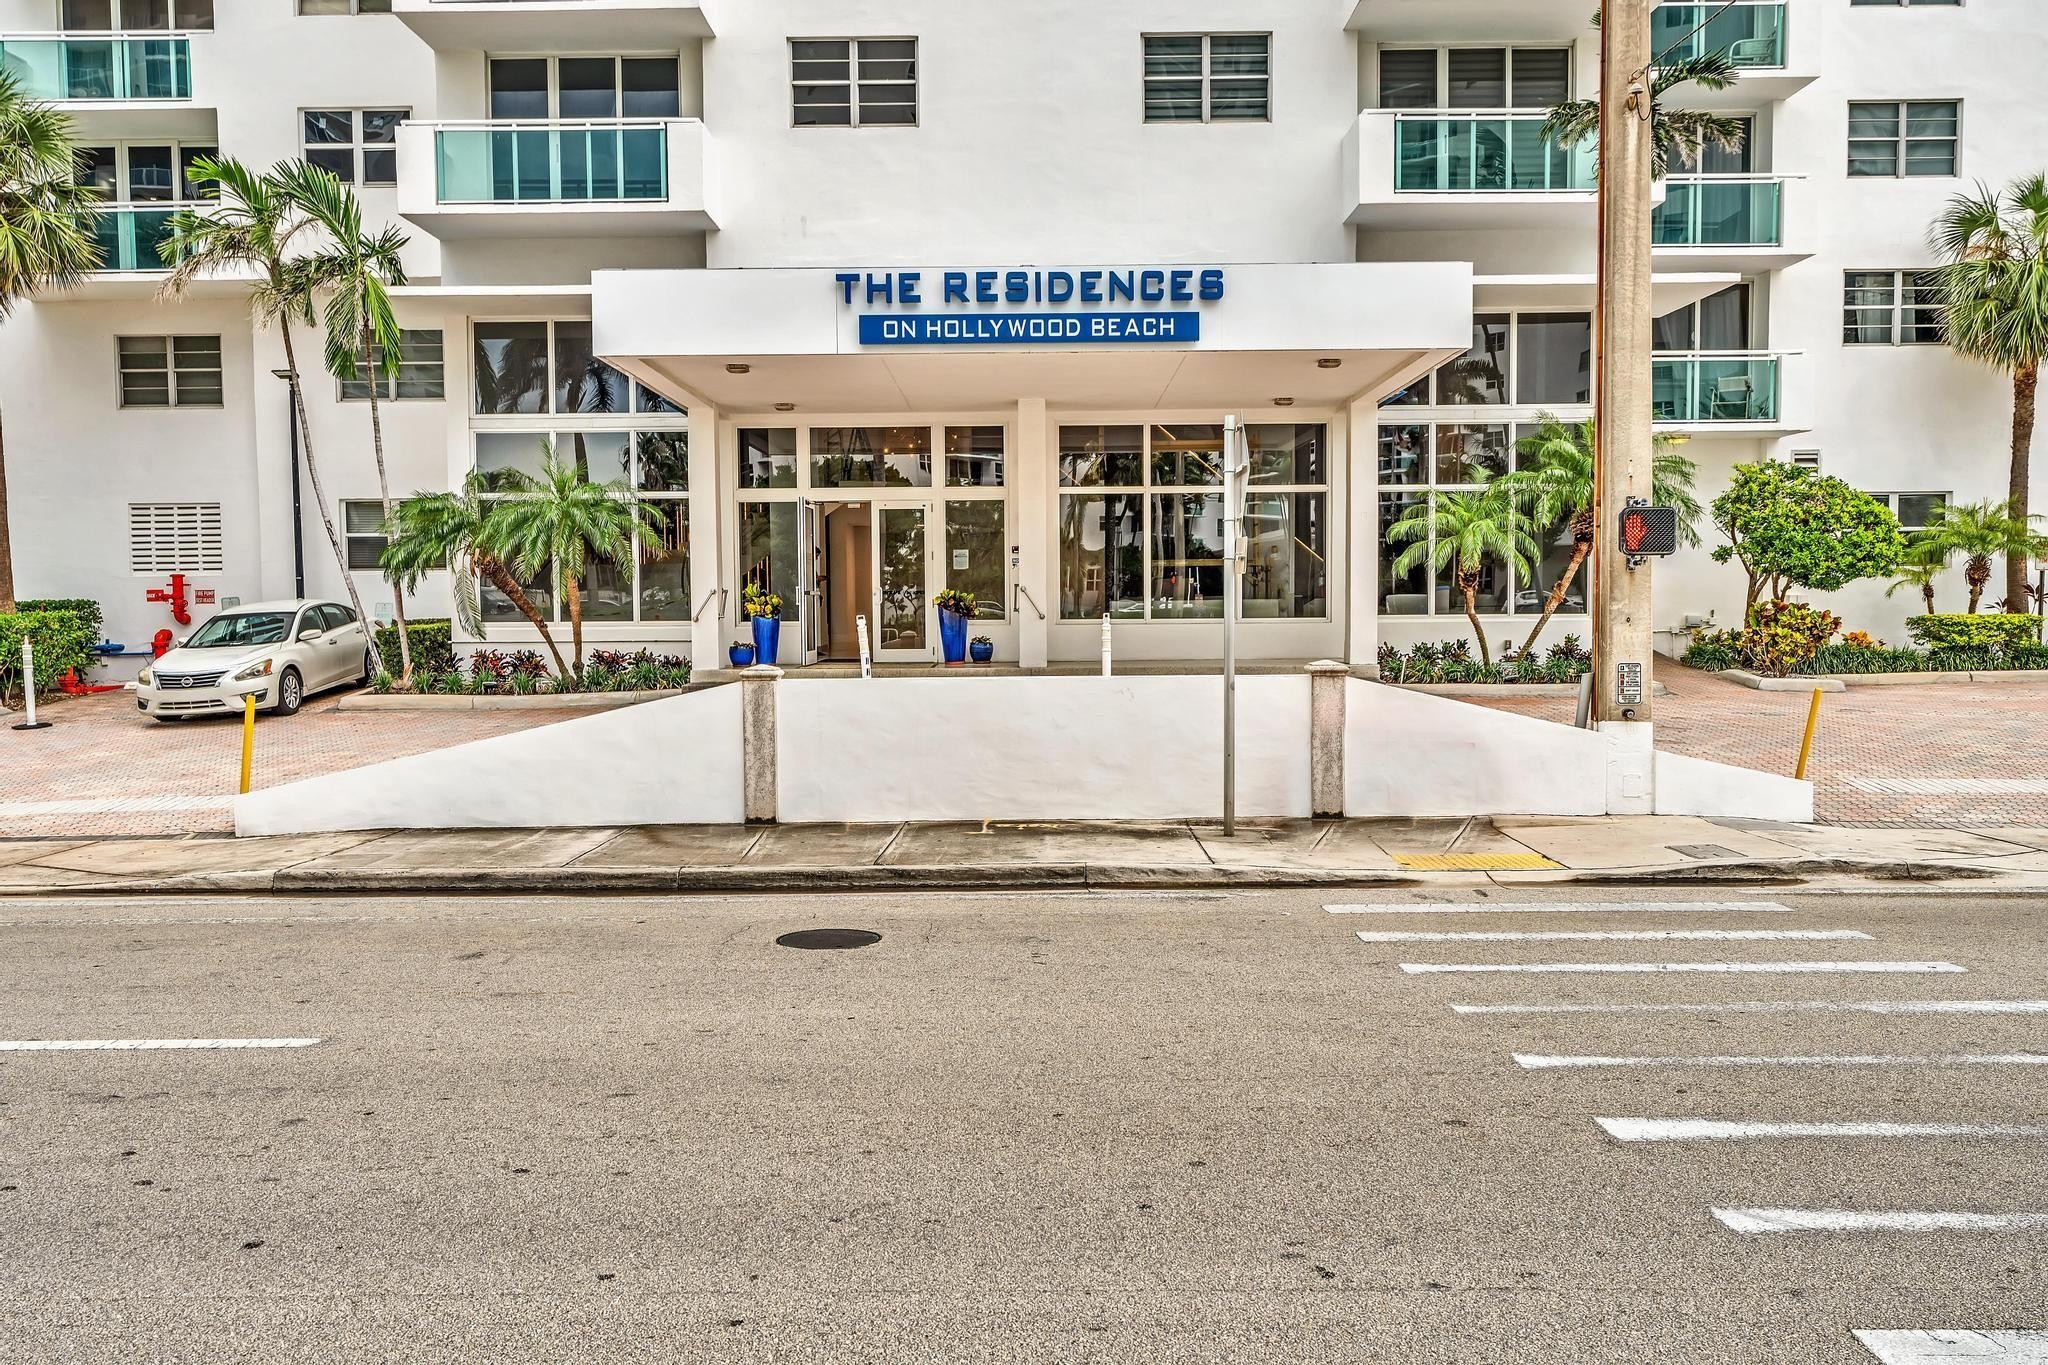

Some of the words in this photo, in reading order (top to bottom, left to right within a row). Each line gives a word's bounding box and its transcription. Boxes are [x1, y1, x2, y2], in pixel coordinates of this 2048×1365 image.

[836, 272, 921, 304] THE
[944, 269, 1224, 304] RESIDENCES
[884, 320, 916, 338] ON
[927, 319, 1080, 338] HOLLYWOOD
[1092, 318, 1174, 337] BEACH
